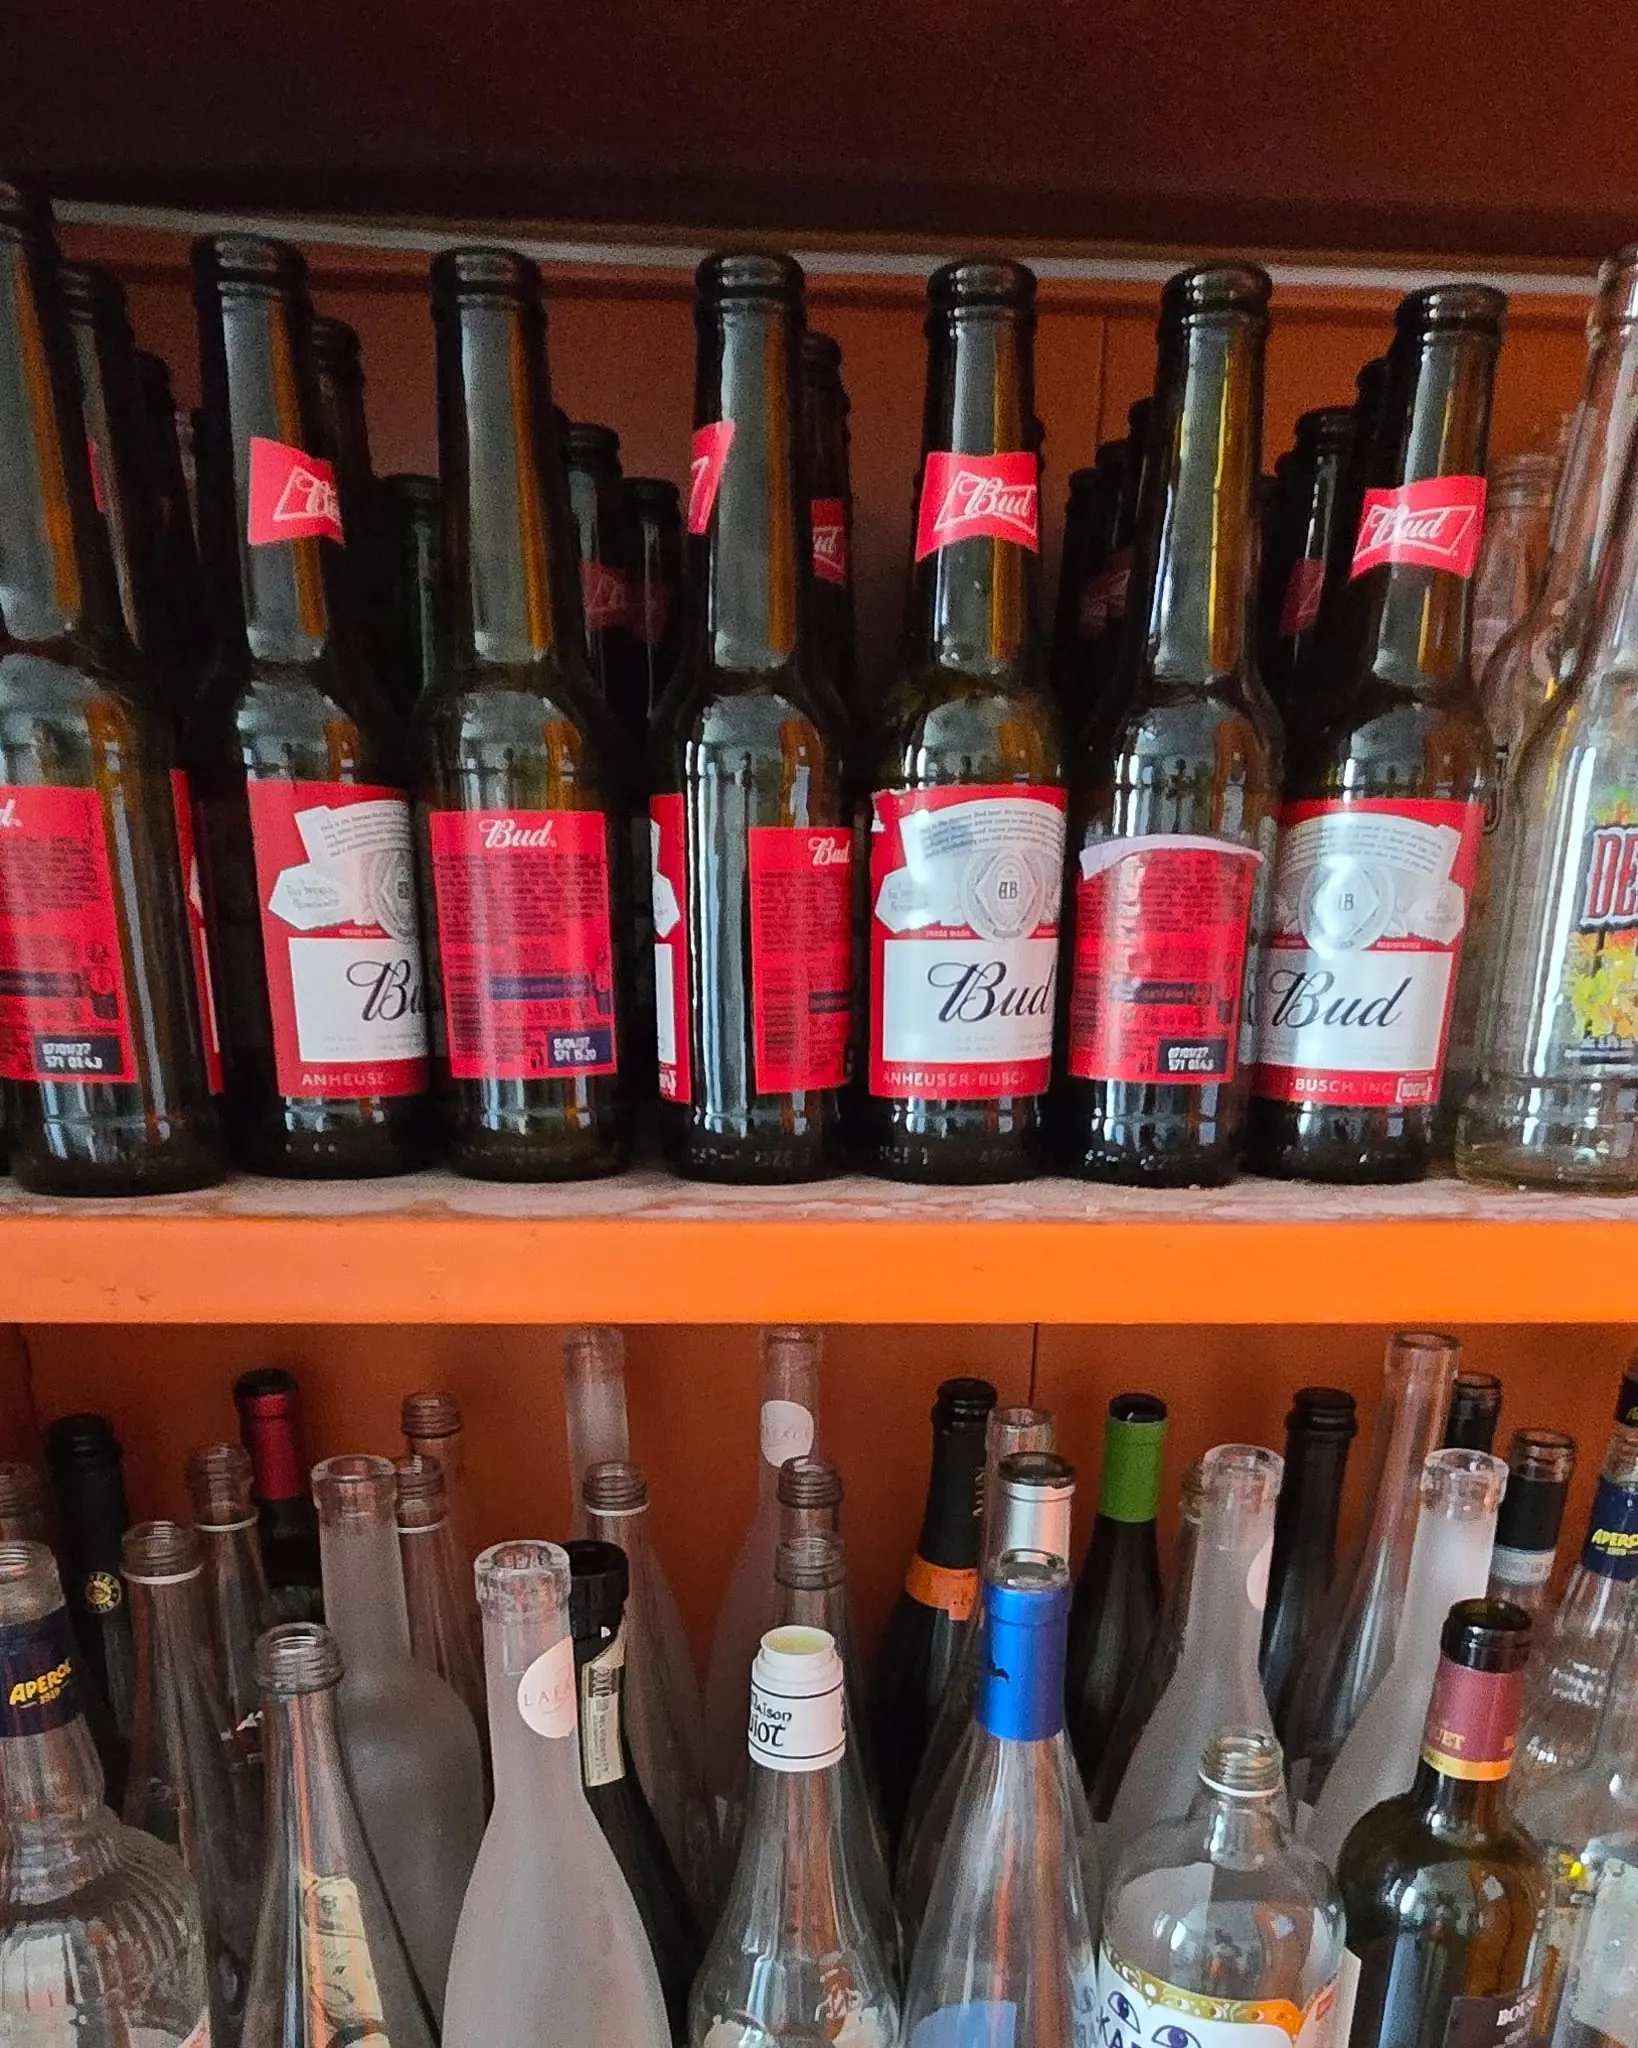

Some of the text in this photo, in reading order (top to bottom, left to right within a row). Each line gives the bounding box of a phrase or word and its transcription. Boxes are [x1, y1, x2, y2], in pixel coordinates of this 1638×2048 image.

[959, 476, 1032, 518] Bud
[1369, 503, 1450, 548] Bud
[479, 818, 555, 849] Bud
[926, 960, 1057, 1024] Bud
[1269, 968, 1413, 1029] Bud
